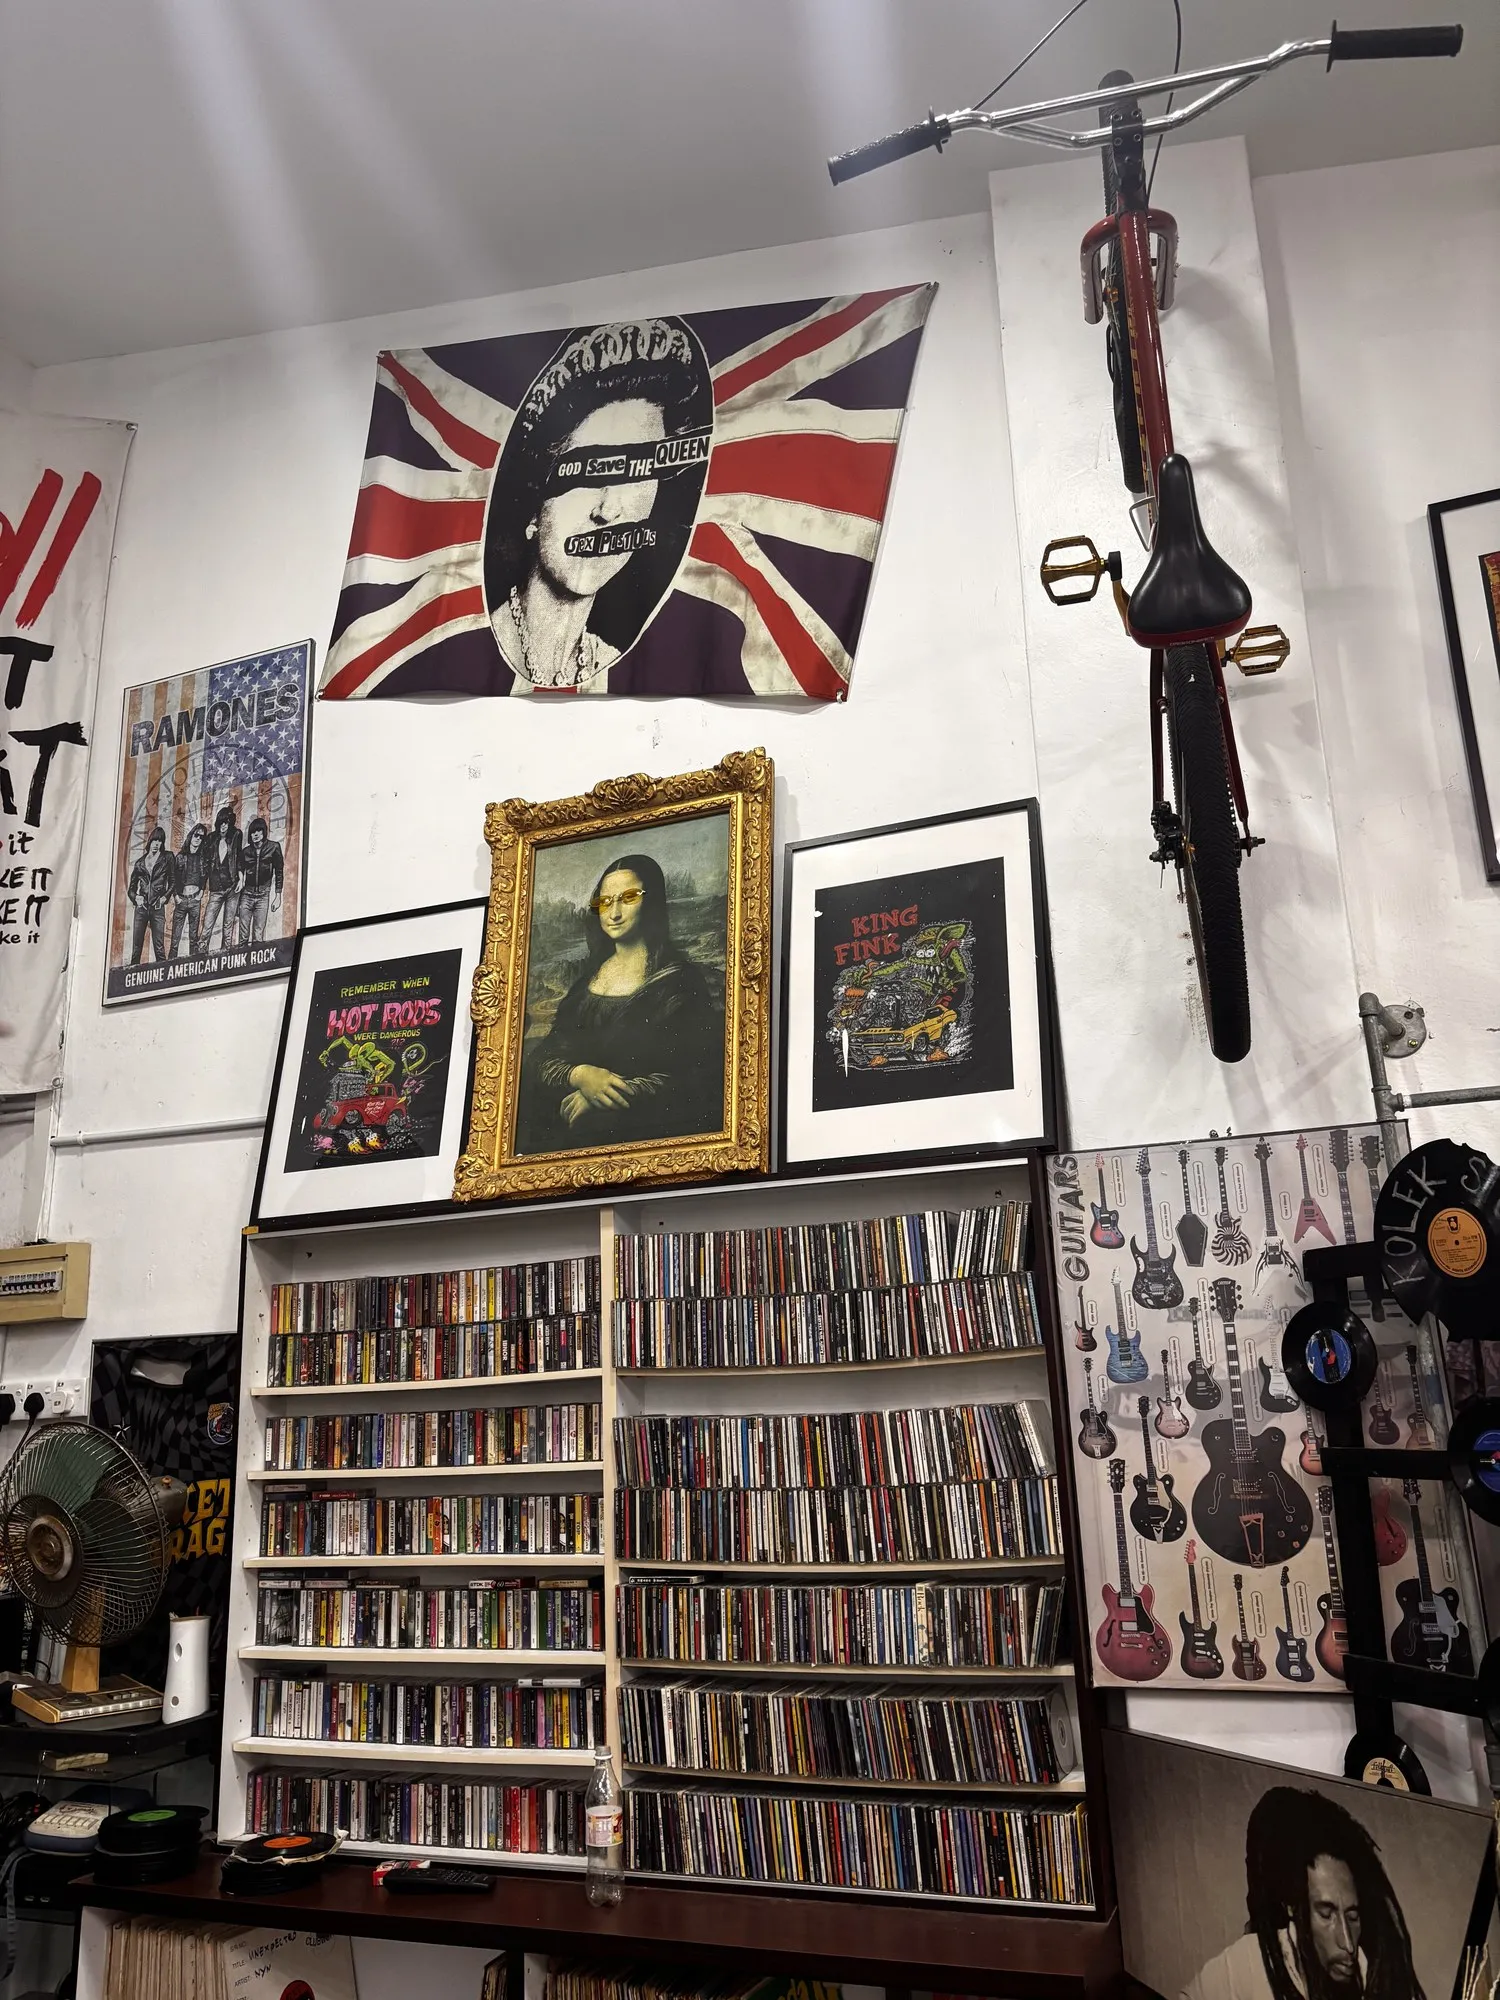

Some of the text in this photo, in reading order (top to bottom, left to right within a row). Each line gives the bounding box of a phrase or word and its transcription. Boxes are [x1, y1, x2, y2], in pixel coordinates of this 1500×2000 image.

[558, 436, 710, 477] GOD Save THE QUEEN
[130, 682, 301, 758] RAMONES
[31, 867, 53, 891] IT
[24, 894, 50, 928] IT
[852, 904, 919, 938] KING
[27, 930, 40, 944] it
[833, 933, 901, 966] FINK
[125, 947, 277, 988] GENUINE AMERICAN PUNK ROCK
[341, 976, 430, 998] REMEMBER WHEN
[327, 998, 442, 1038] HOT RODS
[354, 1029, 421, 1041] WERE DANGEROUS
[1053, 1154, 1090, 1282] GUITARS
